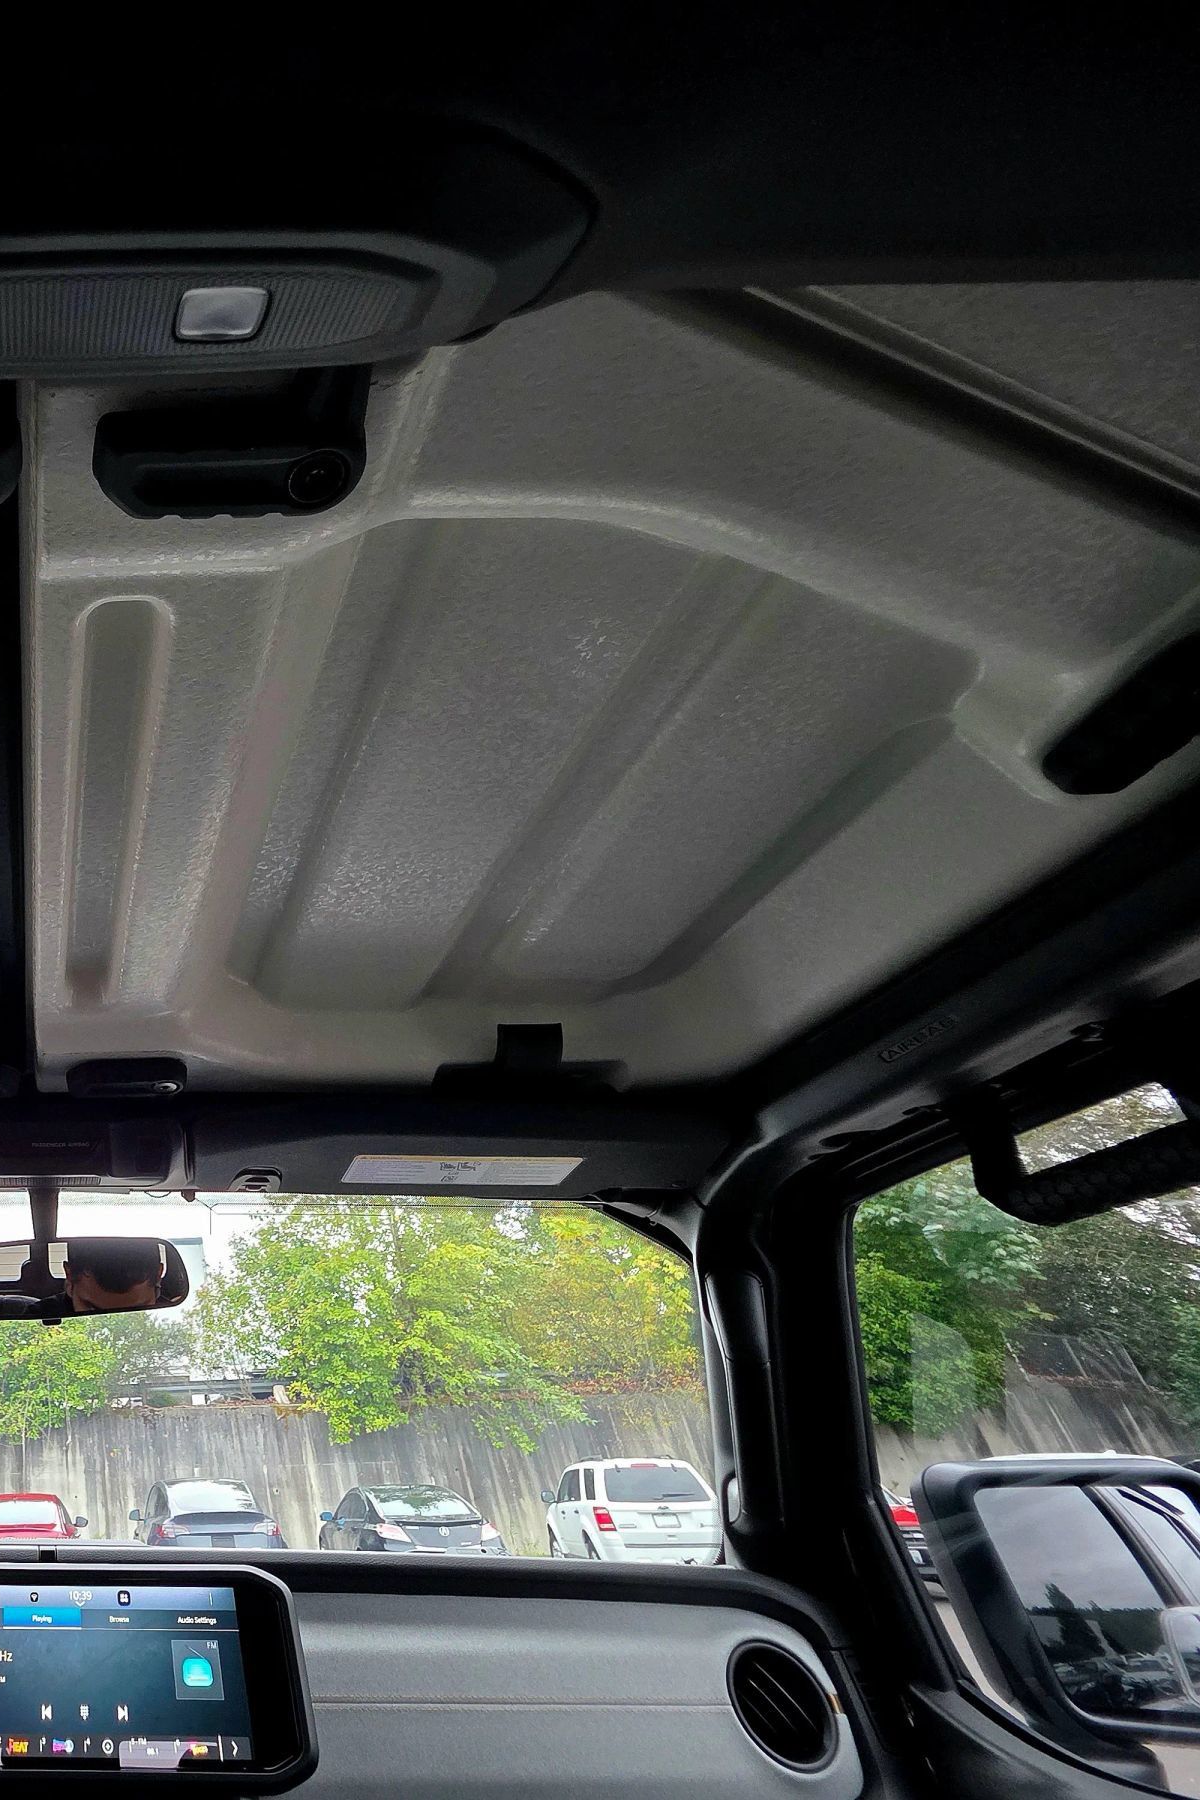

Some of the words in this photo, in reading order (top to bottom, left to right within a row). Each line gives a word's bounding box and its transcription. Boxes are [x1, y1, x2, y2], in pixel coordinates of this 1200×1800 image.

[68, 1590, 92, 1600] 10:39
[31, 1615, 52, 1624] Playing
[109, 1615, 130, 1623] Browse
[177, 1616, 194, 1624] Audio
[194, 1616, 217, 1625] Settings
[206, 1641, 217, 1649] FM
